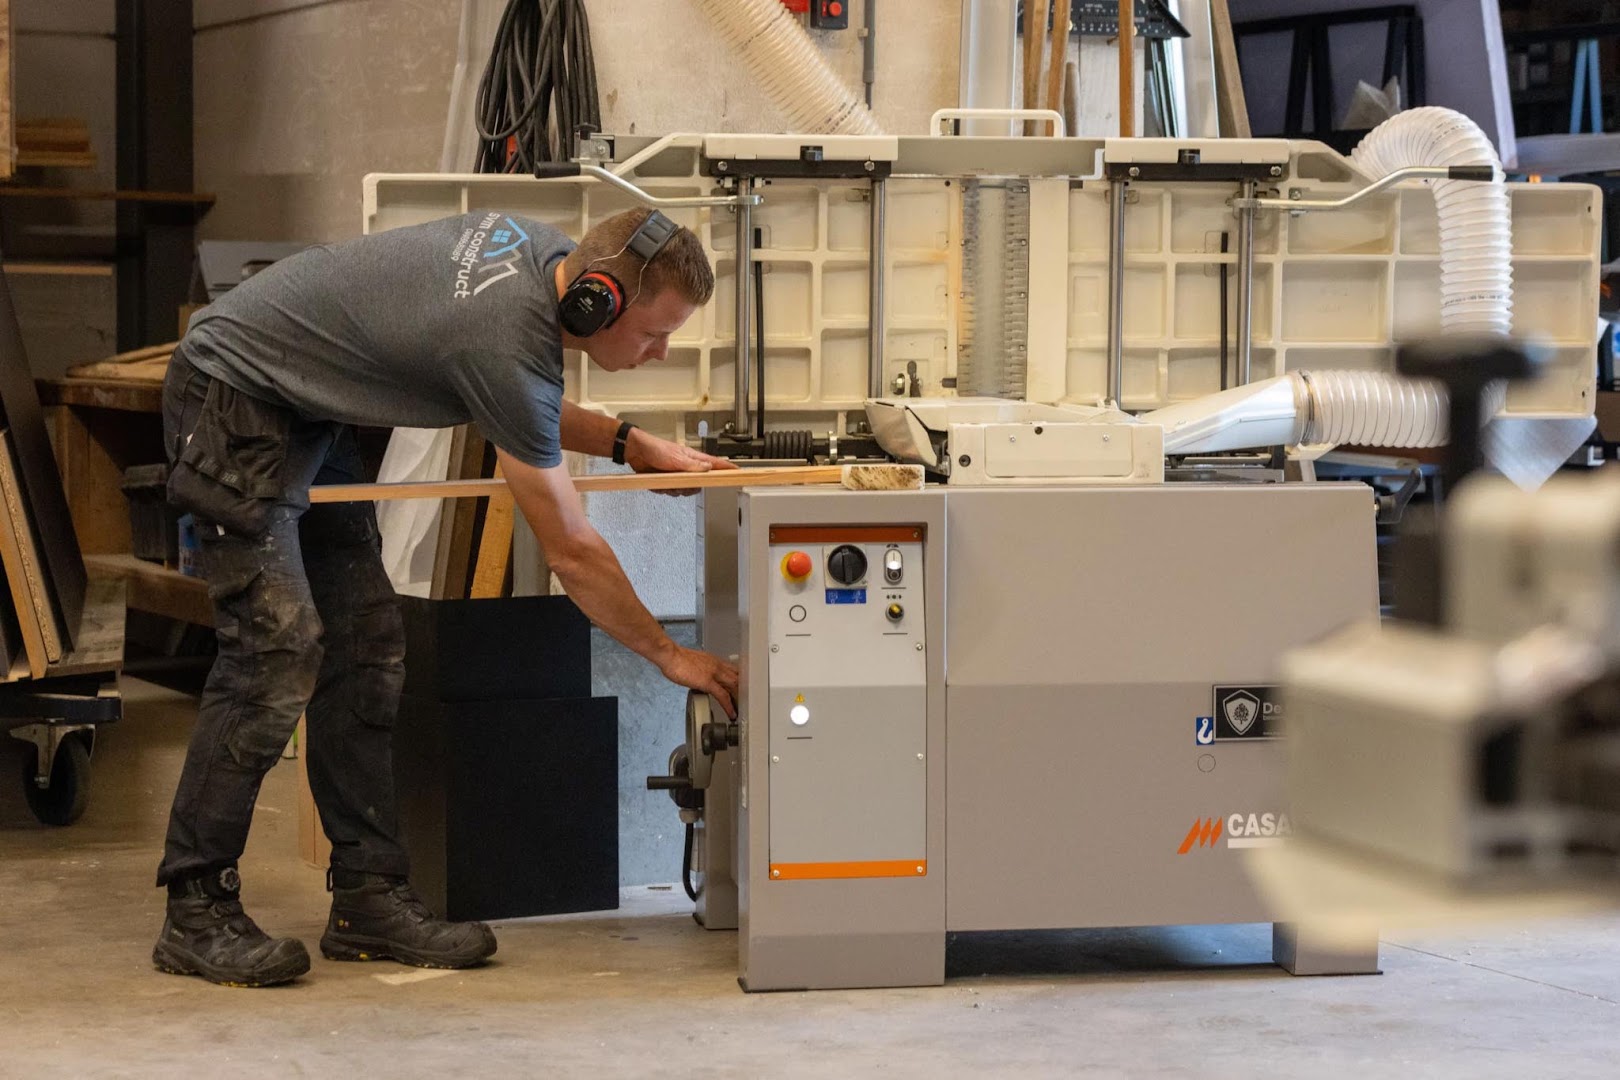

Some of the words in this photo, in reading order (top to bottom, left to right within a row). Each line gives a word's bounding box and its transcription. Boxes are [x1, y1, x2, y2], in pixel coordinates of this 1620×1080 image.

[479, 212, 500, 229] svm
[454, 231, 486, 298] construct
[1228, 813, 1292, 837] CASA
